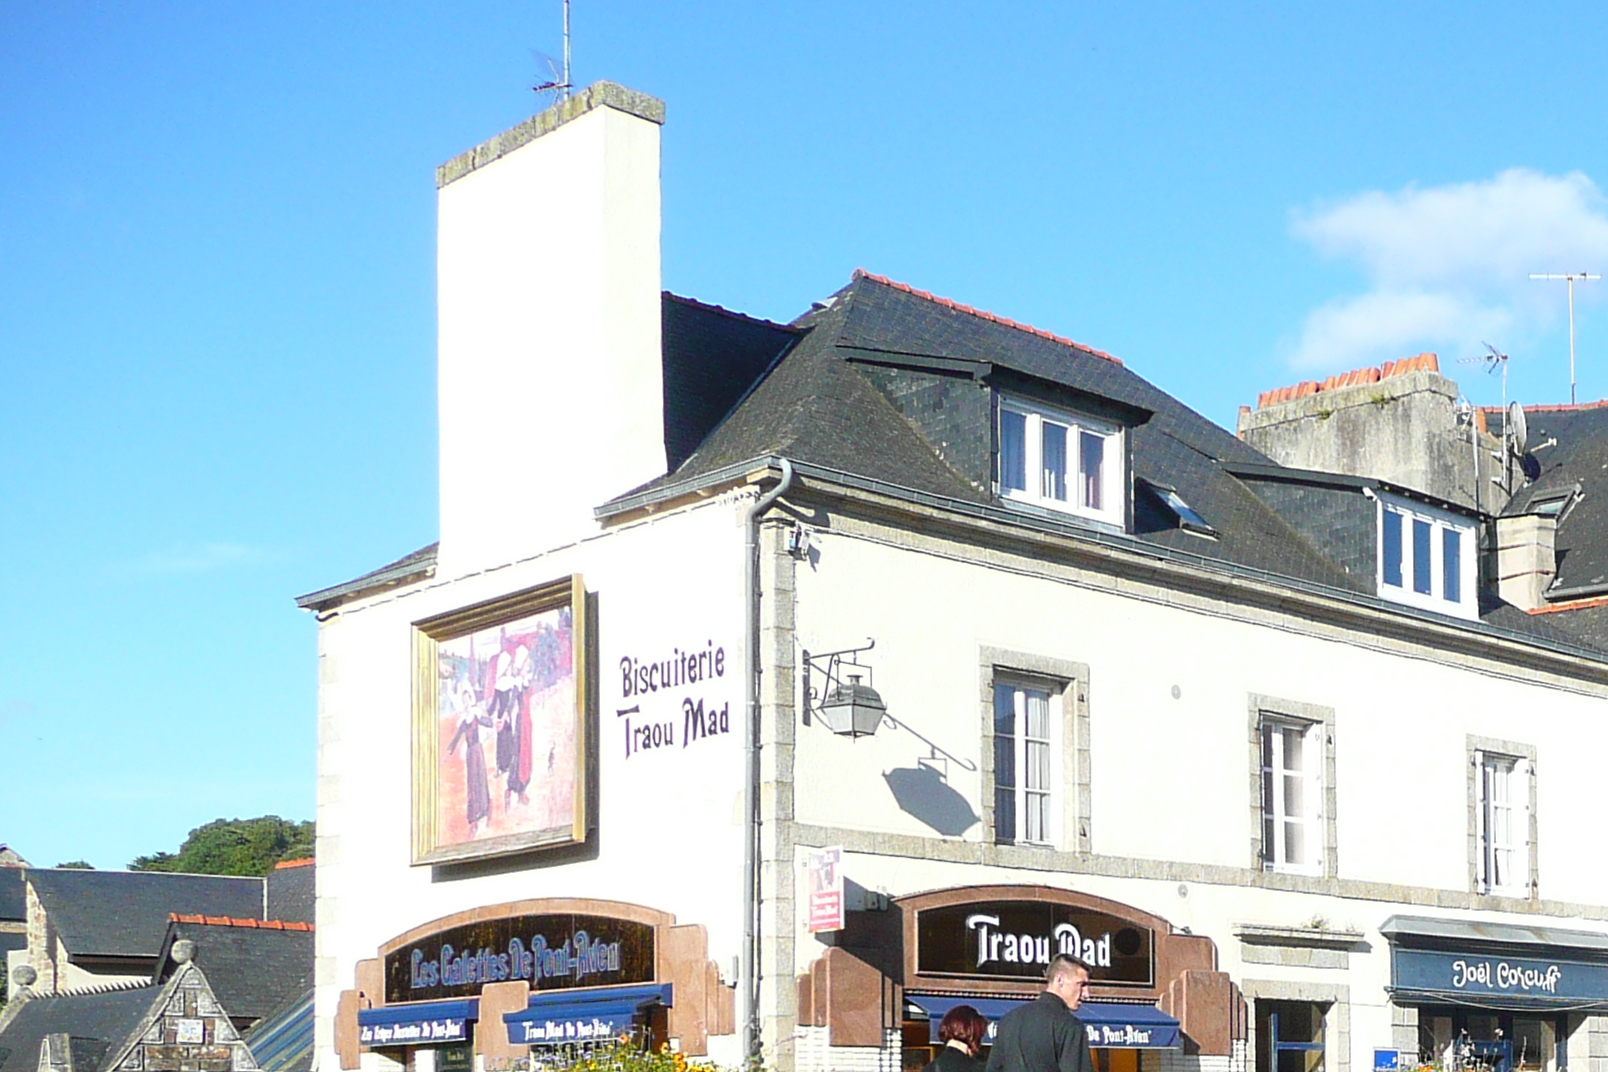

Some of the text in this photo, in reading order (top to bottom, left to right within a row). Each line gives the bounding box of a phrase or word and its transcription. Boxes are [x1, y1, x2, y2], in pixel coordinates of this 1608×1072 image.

[619, 639, 725, 698] Biscuiterie
[616, 697, 729, 761] Traou Mad
[411, 930, 621, 989] Les Galettes De Pont-Aven
[965, 914, 1050, 968] Traou
[1453, 960, 1561, 993] Joël Corcuff
